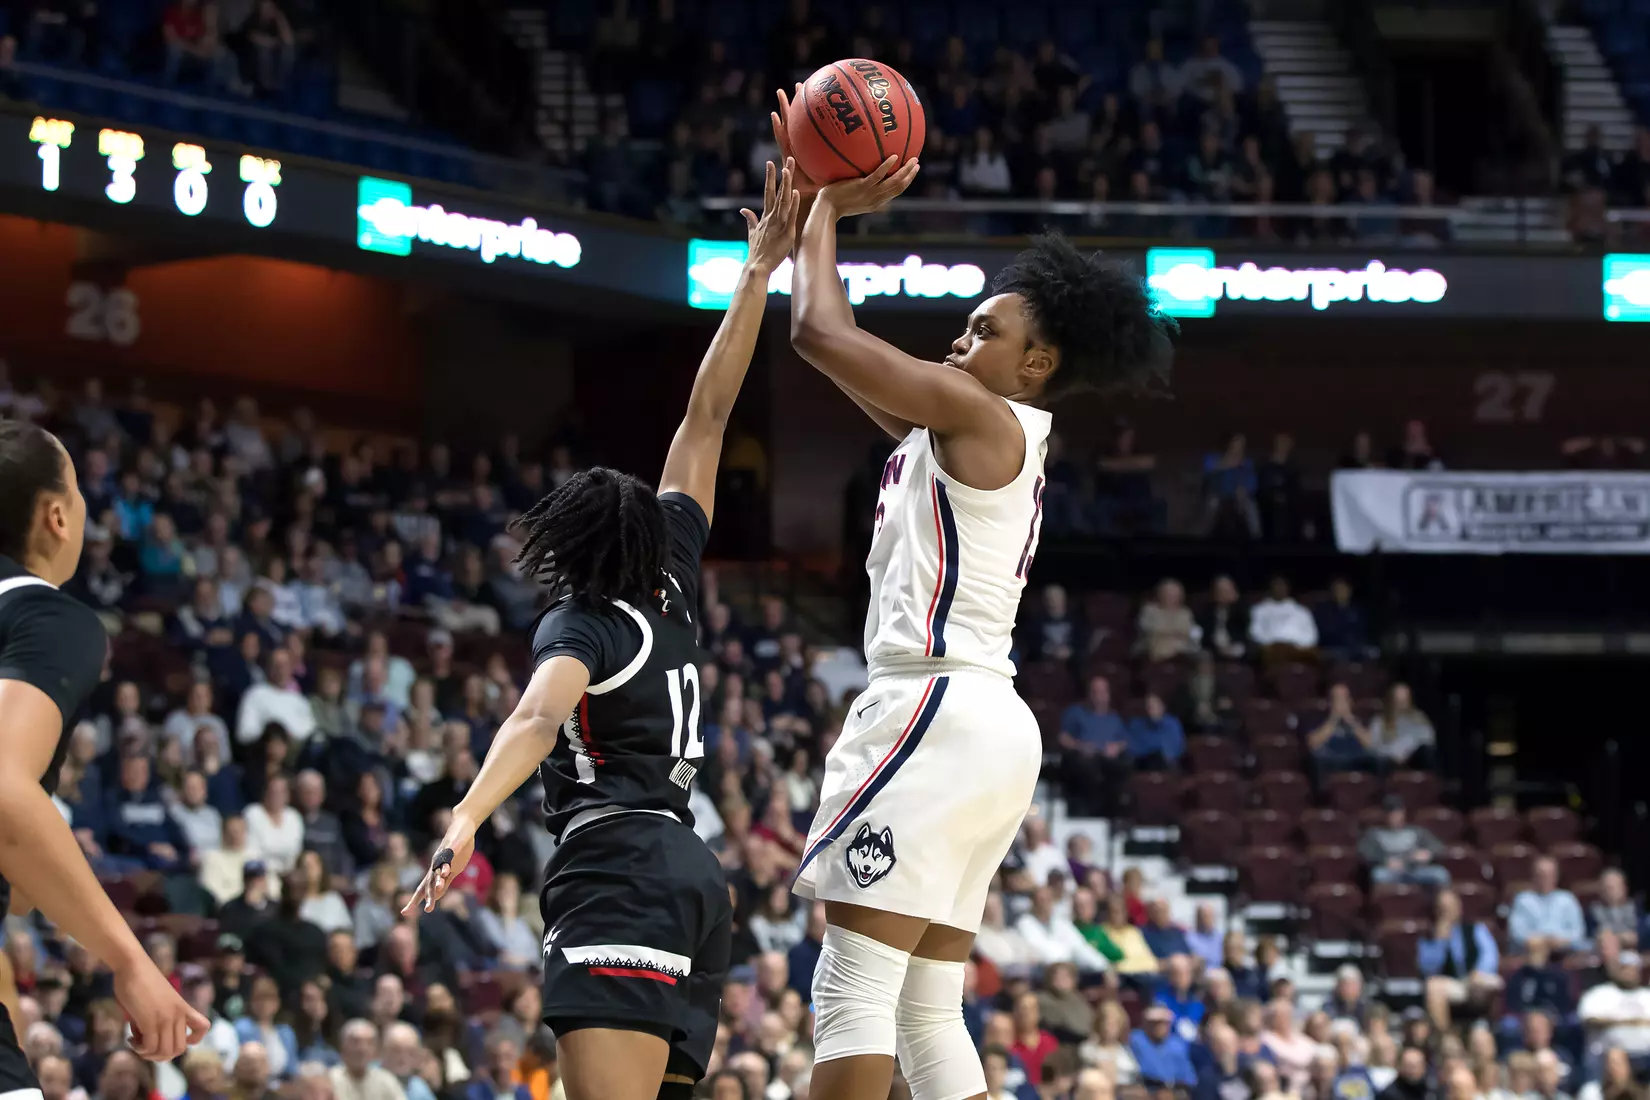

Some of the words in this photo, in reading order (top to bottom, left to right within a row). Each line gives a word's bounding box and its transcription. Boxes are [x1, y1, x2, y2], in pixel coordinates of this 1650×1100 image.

[817, 74, 863, 135] NCAA
[848, 60, 899, 134] Wilson
[65, 281, 141, 346] 26
[1473, 369, 1556, 422] 27
[665, 662, 705, 759] 12
